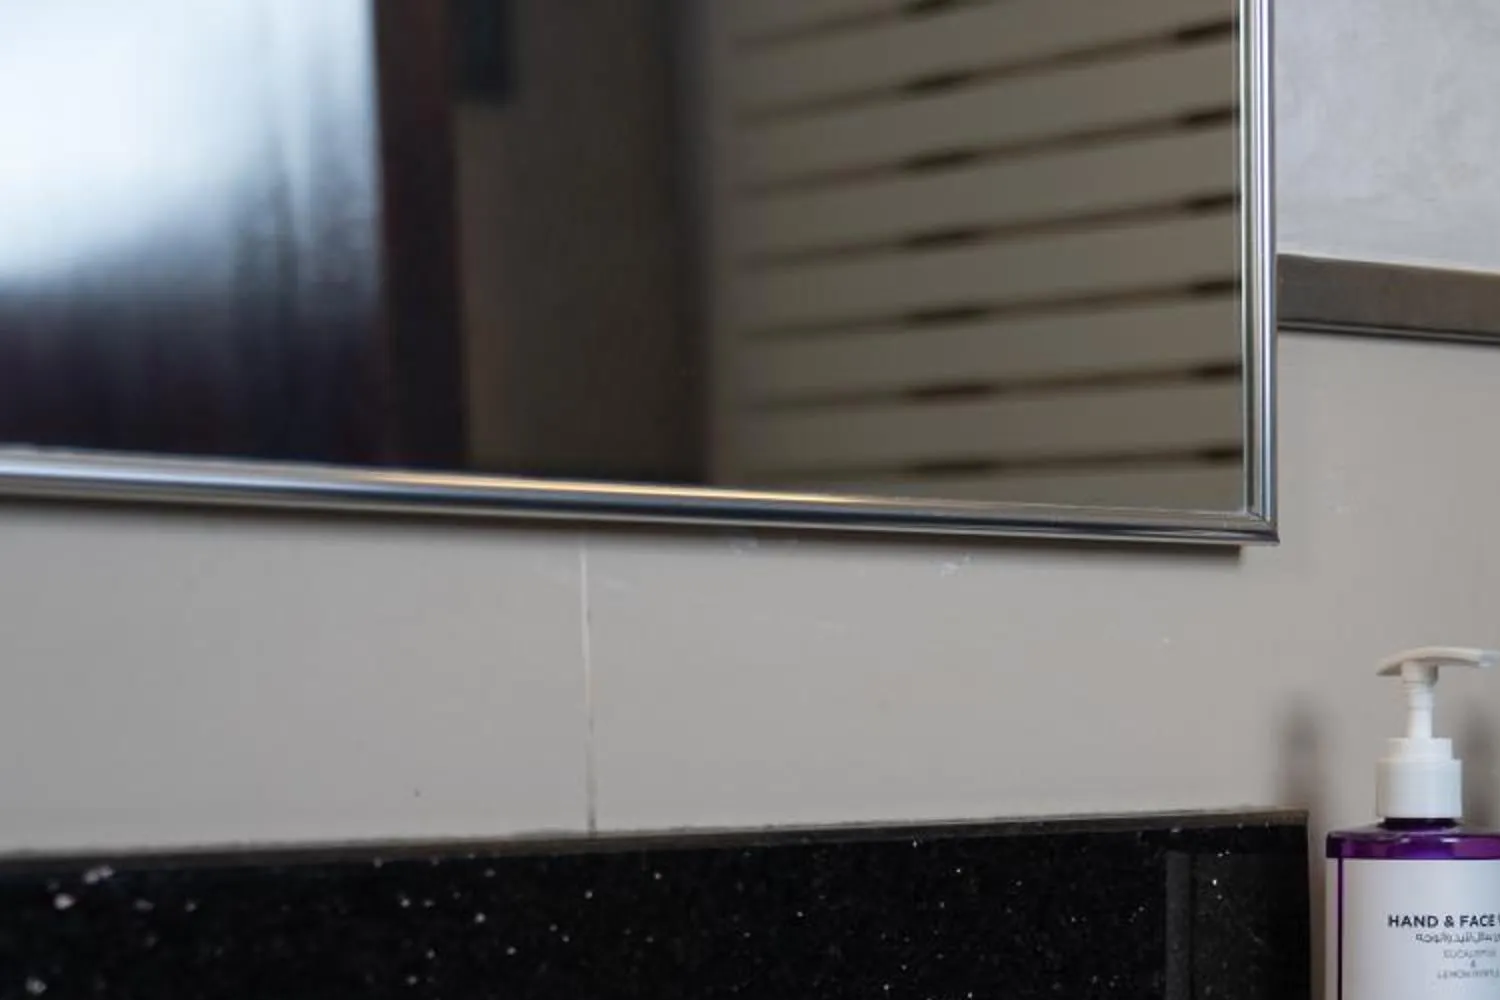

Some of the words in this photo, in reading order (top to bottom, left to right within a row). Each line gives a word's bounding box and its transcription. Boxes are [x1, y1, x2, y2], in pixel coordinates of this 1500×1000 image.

[1387, 914, 1439, 928] HAND
[1443, 914, 1455, 928] &
[1459, 913, 1496, 928] FACE
